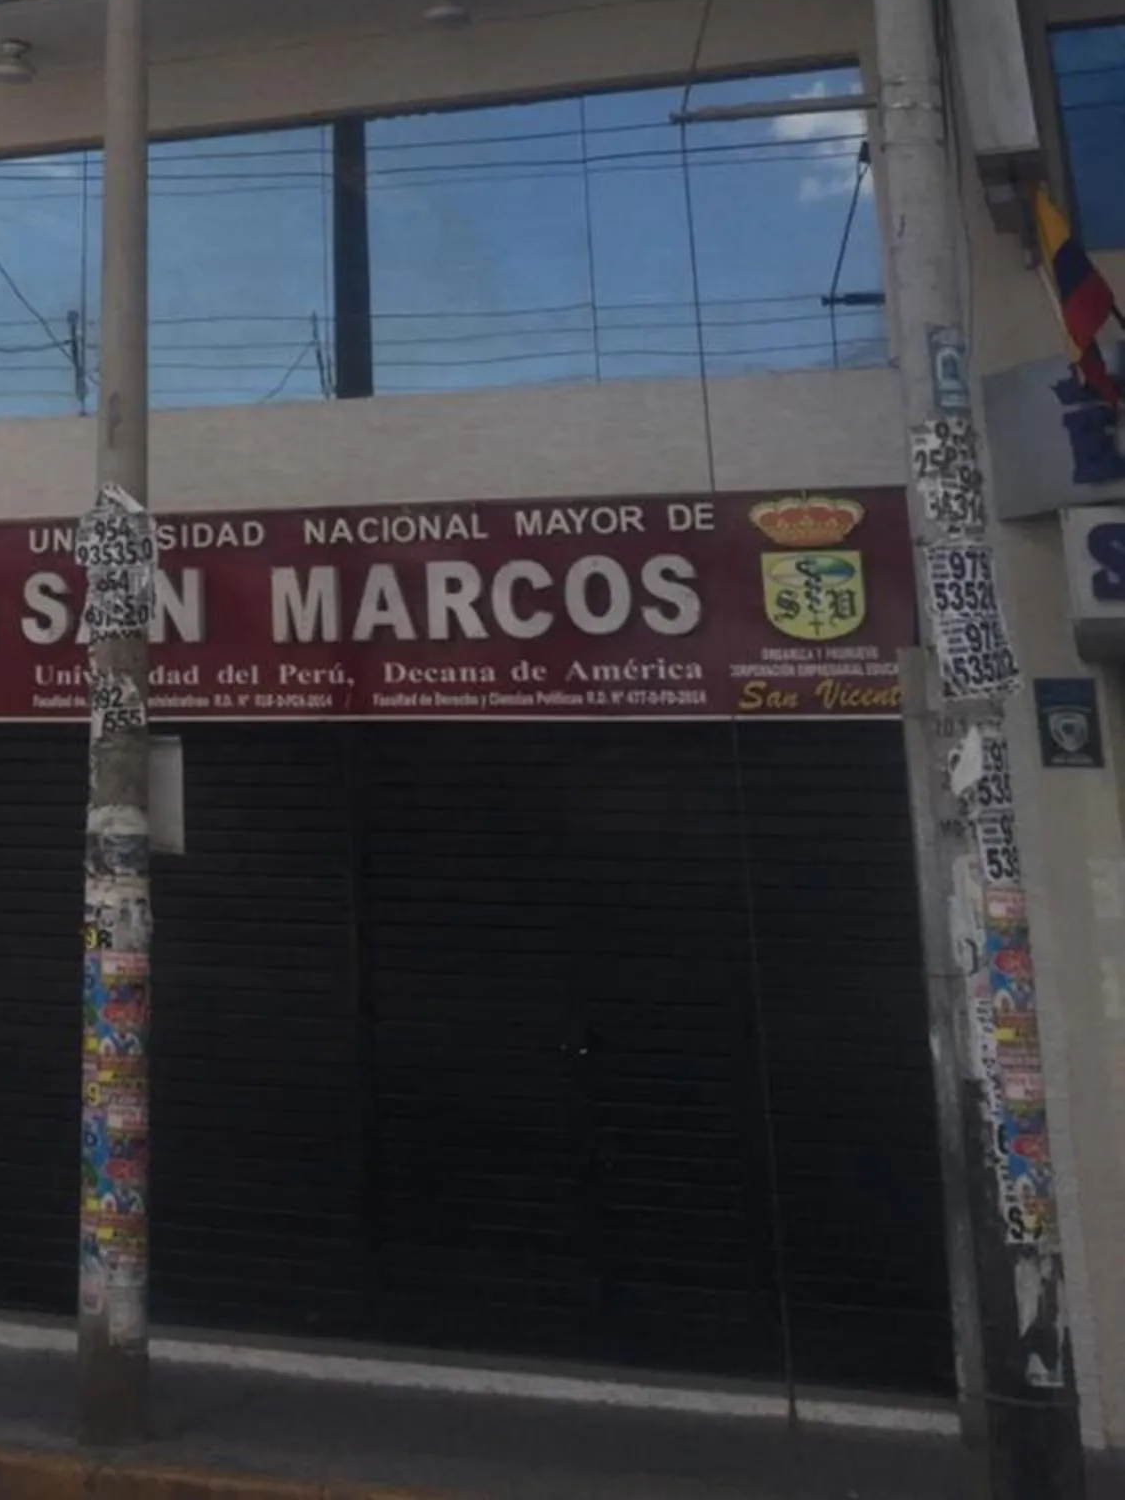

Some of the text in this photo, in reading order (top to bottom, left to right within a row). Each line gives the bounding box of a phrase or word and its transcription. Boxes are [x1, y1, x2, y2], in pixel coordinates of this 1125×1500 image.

[28, 503, 714, 553] UNSIDAD NACIONAL MAYOR DE
[21, 554, 701, 644] SN MARCOS
[35, 664, 199, 685] Univdad
[217, 664, 259, 685] del
[383, 661, 495, 683] Decana
[511, 660, 547, 682] de
[565, 657, 703, 682] América
[738, 678, 902, 711] San Vicent
